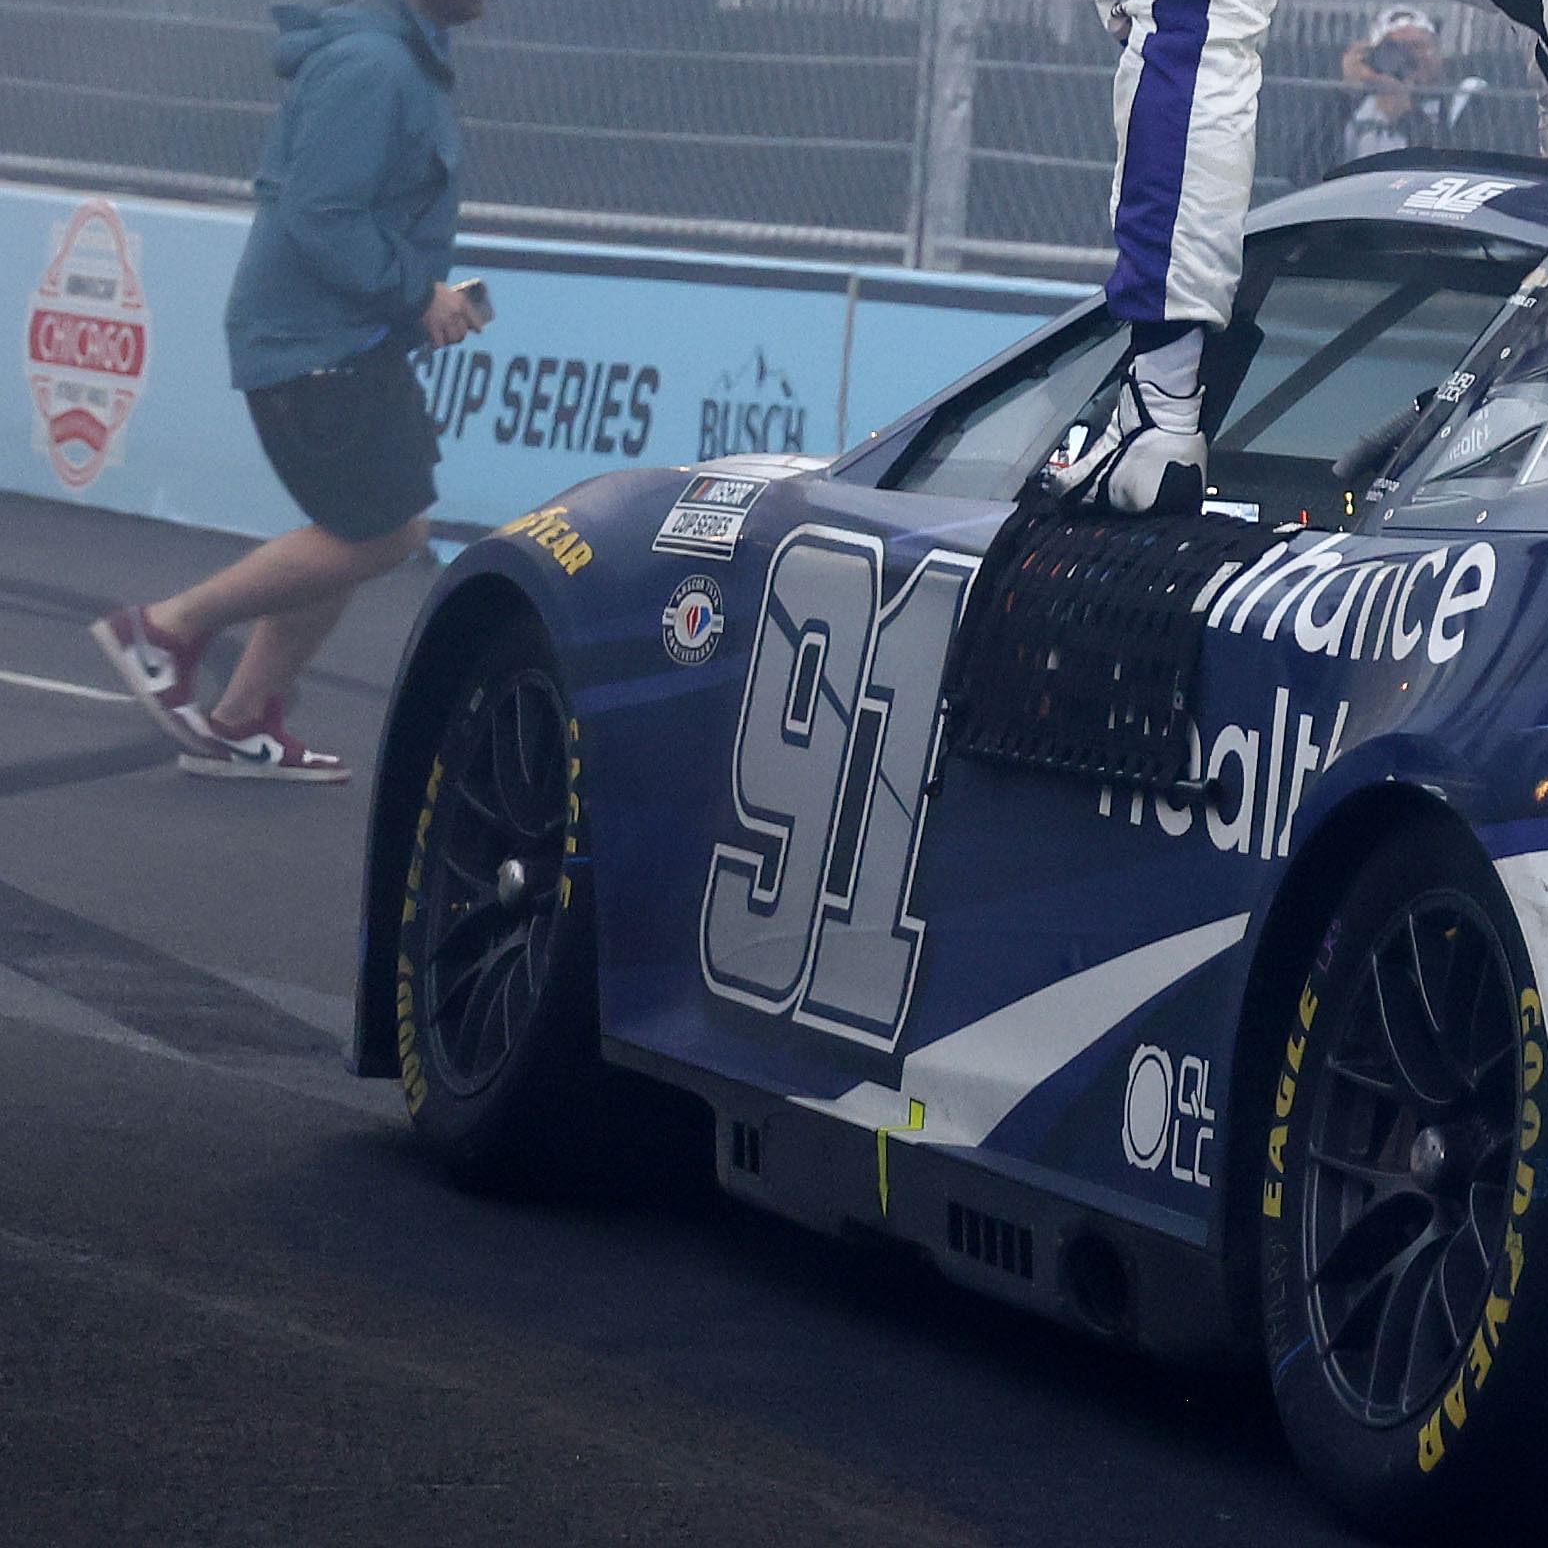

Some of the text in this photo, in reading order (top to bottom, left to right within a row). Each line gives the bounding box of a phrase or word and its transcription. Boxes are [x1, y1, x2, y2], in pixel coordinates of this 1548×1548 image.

[495, 355, 661, 458] SERIES
[699, 396, 806, 462] BUSCH
[672, 511, 734, 537] CUP SERIES
[704, 480, 755, 506] NASCAR
[699, 522, 984, 1054] 91
[1261, 972, 1320, 1219] EAGLE
[1417, 986, 1544, 1474] GOODYEAR
